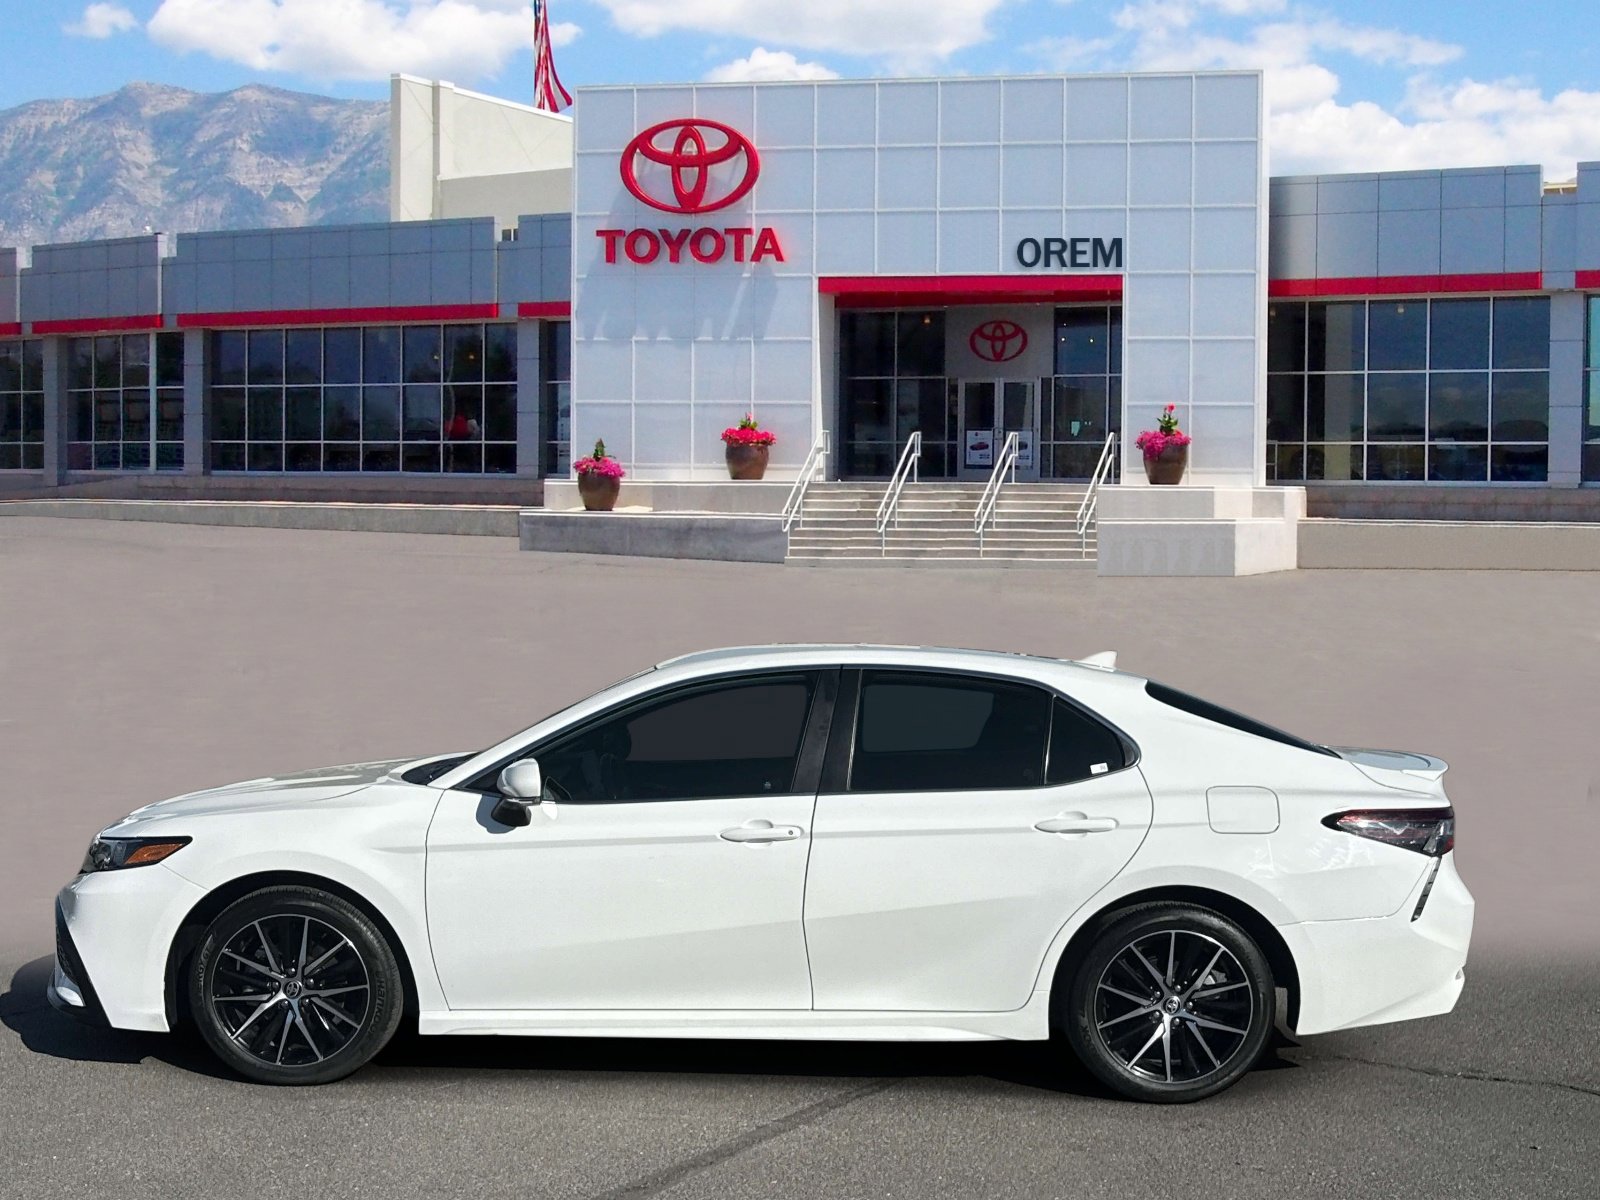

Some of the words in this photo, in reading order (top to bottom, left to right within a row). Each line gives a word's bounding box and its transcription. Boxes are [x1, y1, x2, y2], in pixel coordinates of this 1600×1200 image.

[596, 227, 785, 264] TOYOTA
[1017, 237, 1123, 268] OREM
[366, 979, 385, 1038] Hankoo
